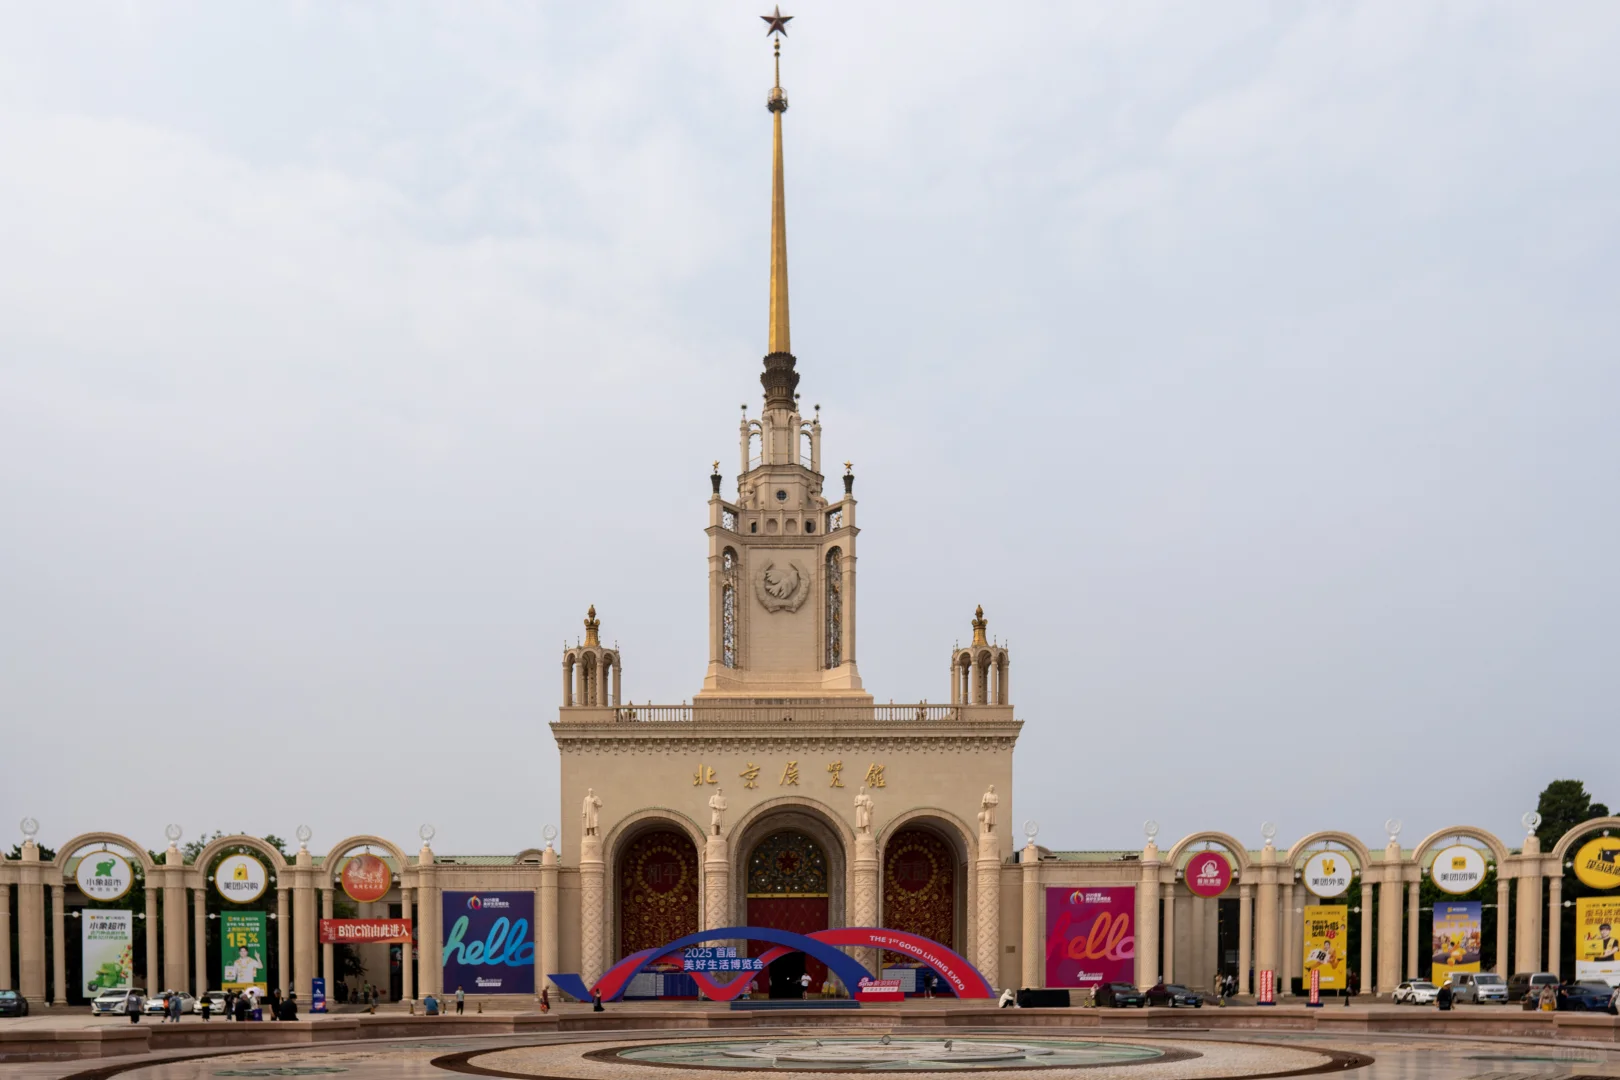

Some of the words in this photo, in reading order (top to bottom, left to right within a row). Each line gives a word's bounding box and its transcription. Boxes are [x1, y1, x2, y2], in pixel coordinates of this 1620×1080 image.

[645, 862, 679, 884] 和平
[1440, 872, 1477, 881] 美团团购
[86, 878, 122, 887] 小象超市
[224, 881, 259, 890] 美团闪购
[1312, 878, 1344, 886] 美团外卖
[89, 922, 127, 930] 小象超市
[338, 923, 409, 938] B馆C馆由此进入
[443, 915, 534, 967] hello
[1046, 911, 1134, 961] hello
[685, 948, 713, 958] 2025
[716, 947, 736, 958] 首届
[684, 959, 764, 970] 美好生活博览会
[869, 935, 887, 943] THE
[899, 941, 923, 955] GOOD
[923, 951, 948, 973] LIVING
[947, 969, 966, 991] EXPO
